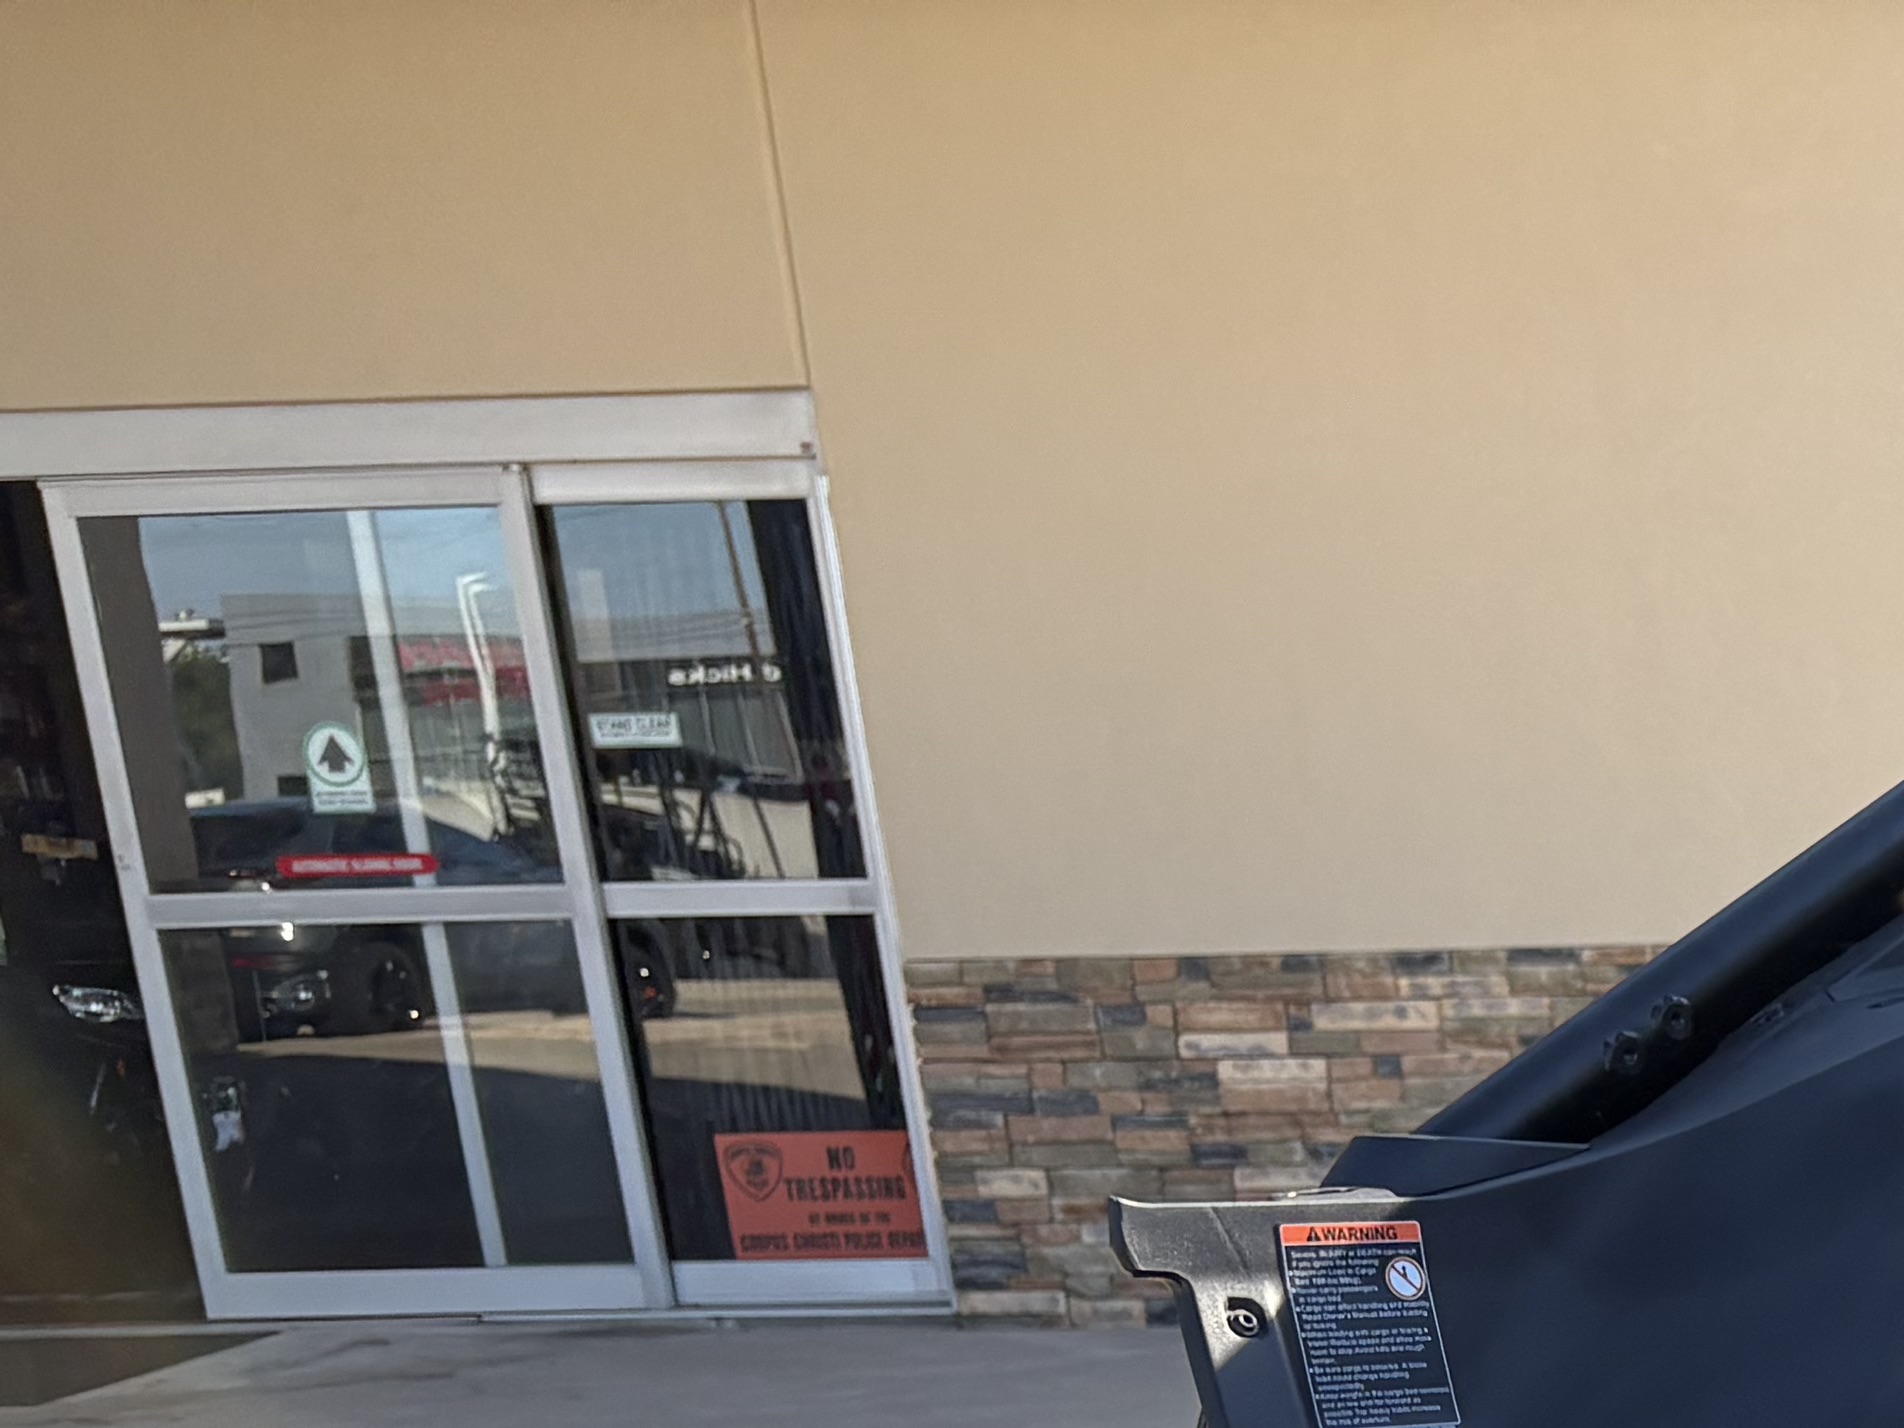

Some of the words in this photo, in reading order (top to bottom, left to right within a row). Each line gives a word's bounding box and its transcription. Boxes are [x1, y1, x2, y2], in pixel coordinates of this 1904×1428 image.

[825, 1147, 856, 1170] NO
[784, 1176, 907, 1201] TRESPASSING
[1321, 1226, 1398, 1241] WARNING
